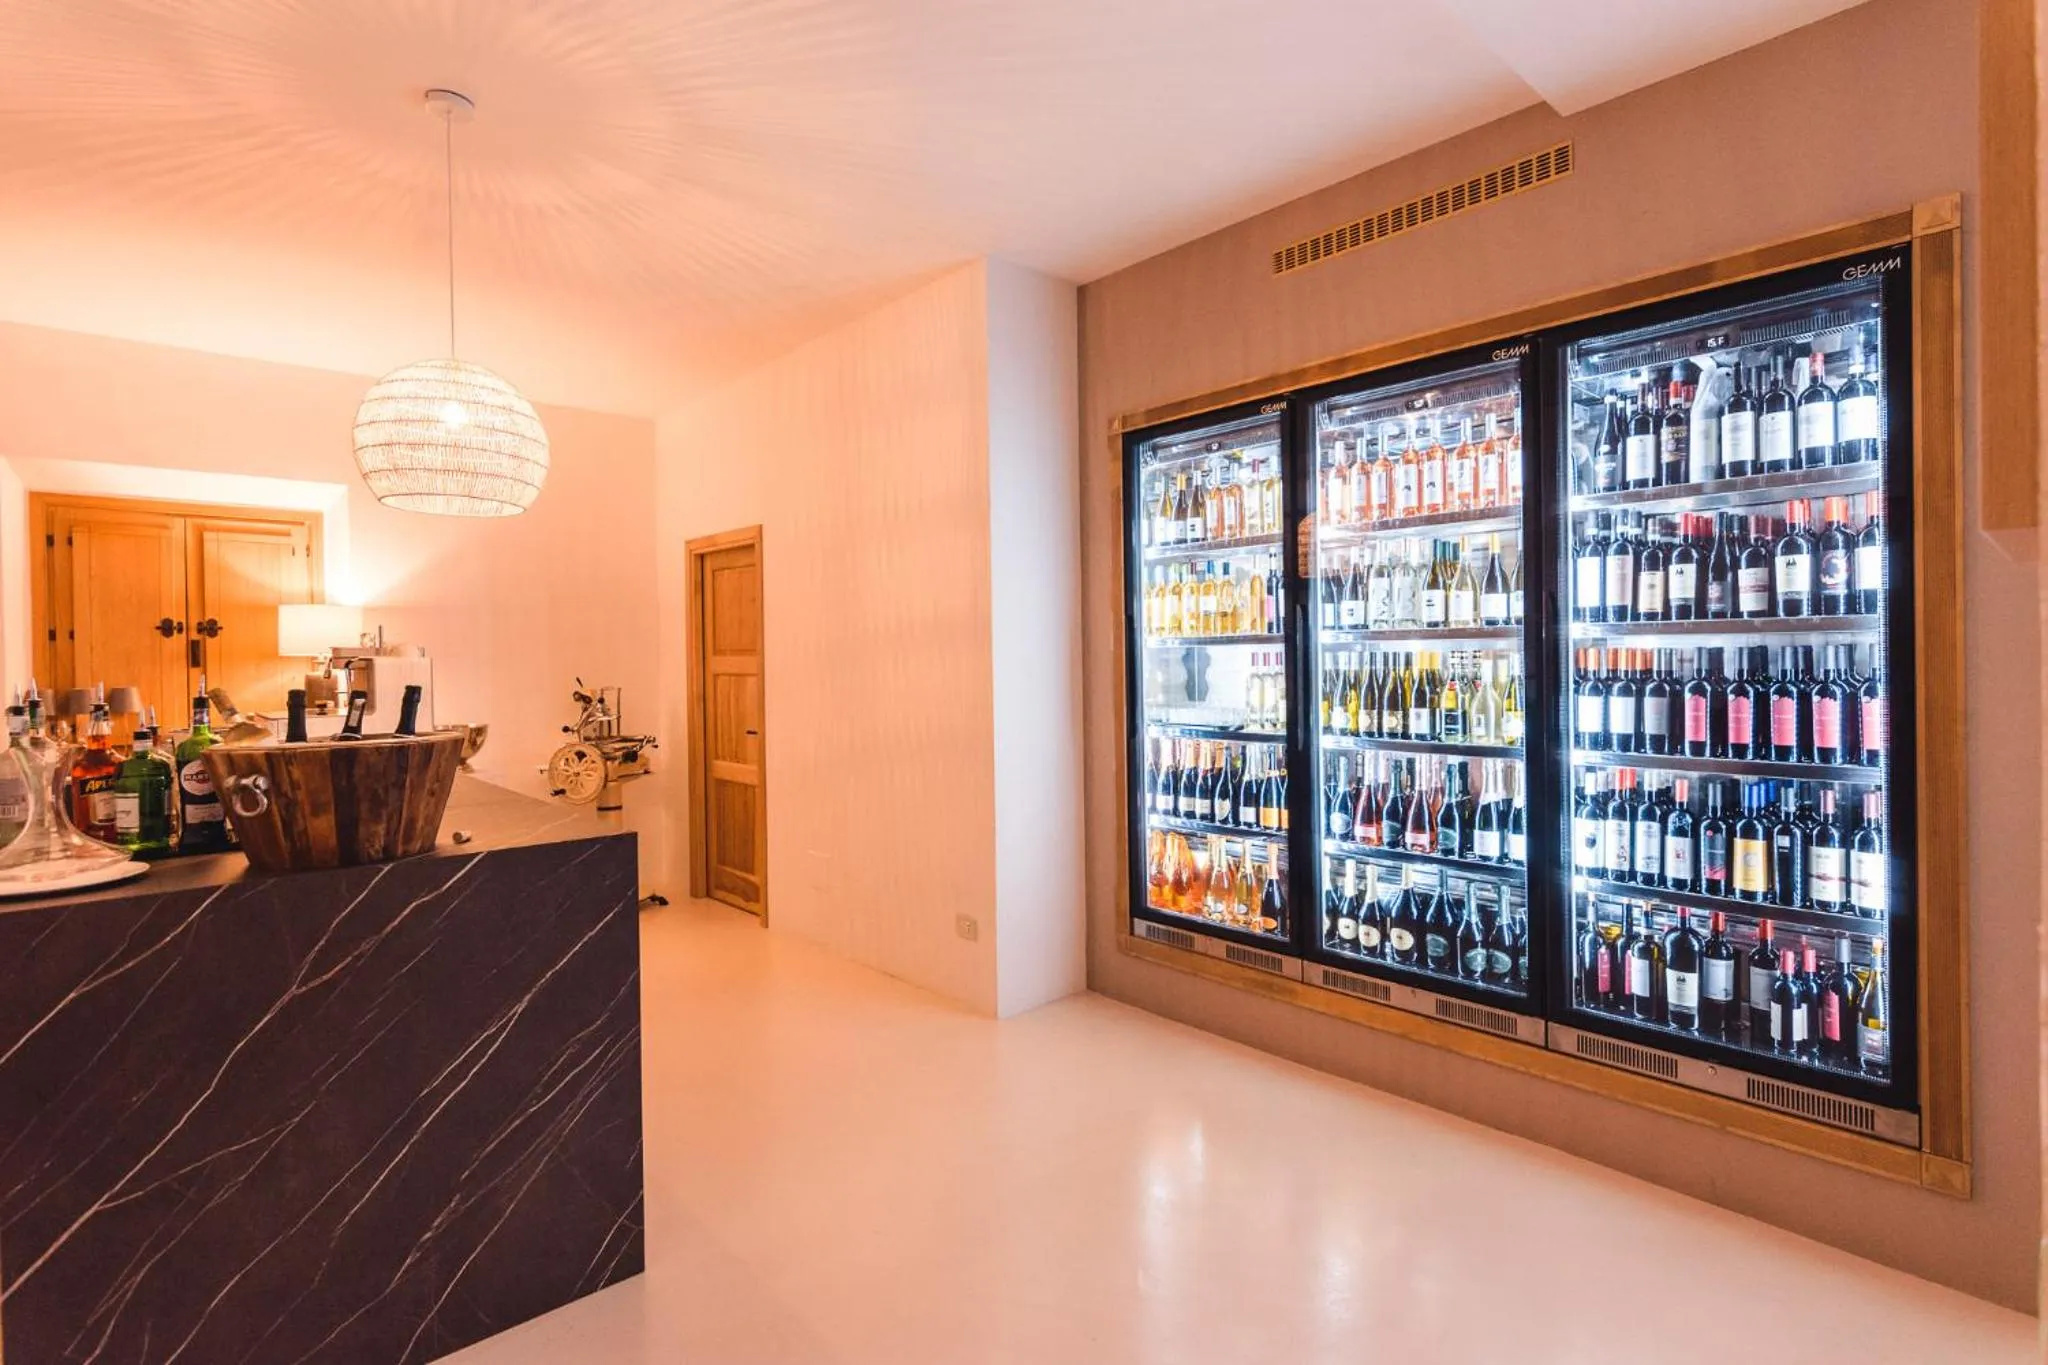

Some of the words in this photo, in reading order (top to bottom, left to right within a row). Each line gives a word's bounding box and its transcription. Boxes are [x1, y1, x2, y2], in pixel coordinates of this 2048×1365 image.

[1842, 256, 1901, 281] GEMM
[1491, 343, 1530, 361] GEMM
[1260, 400, 1287, 415] GEMM
